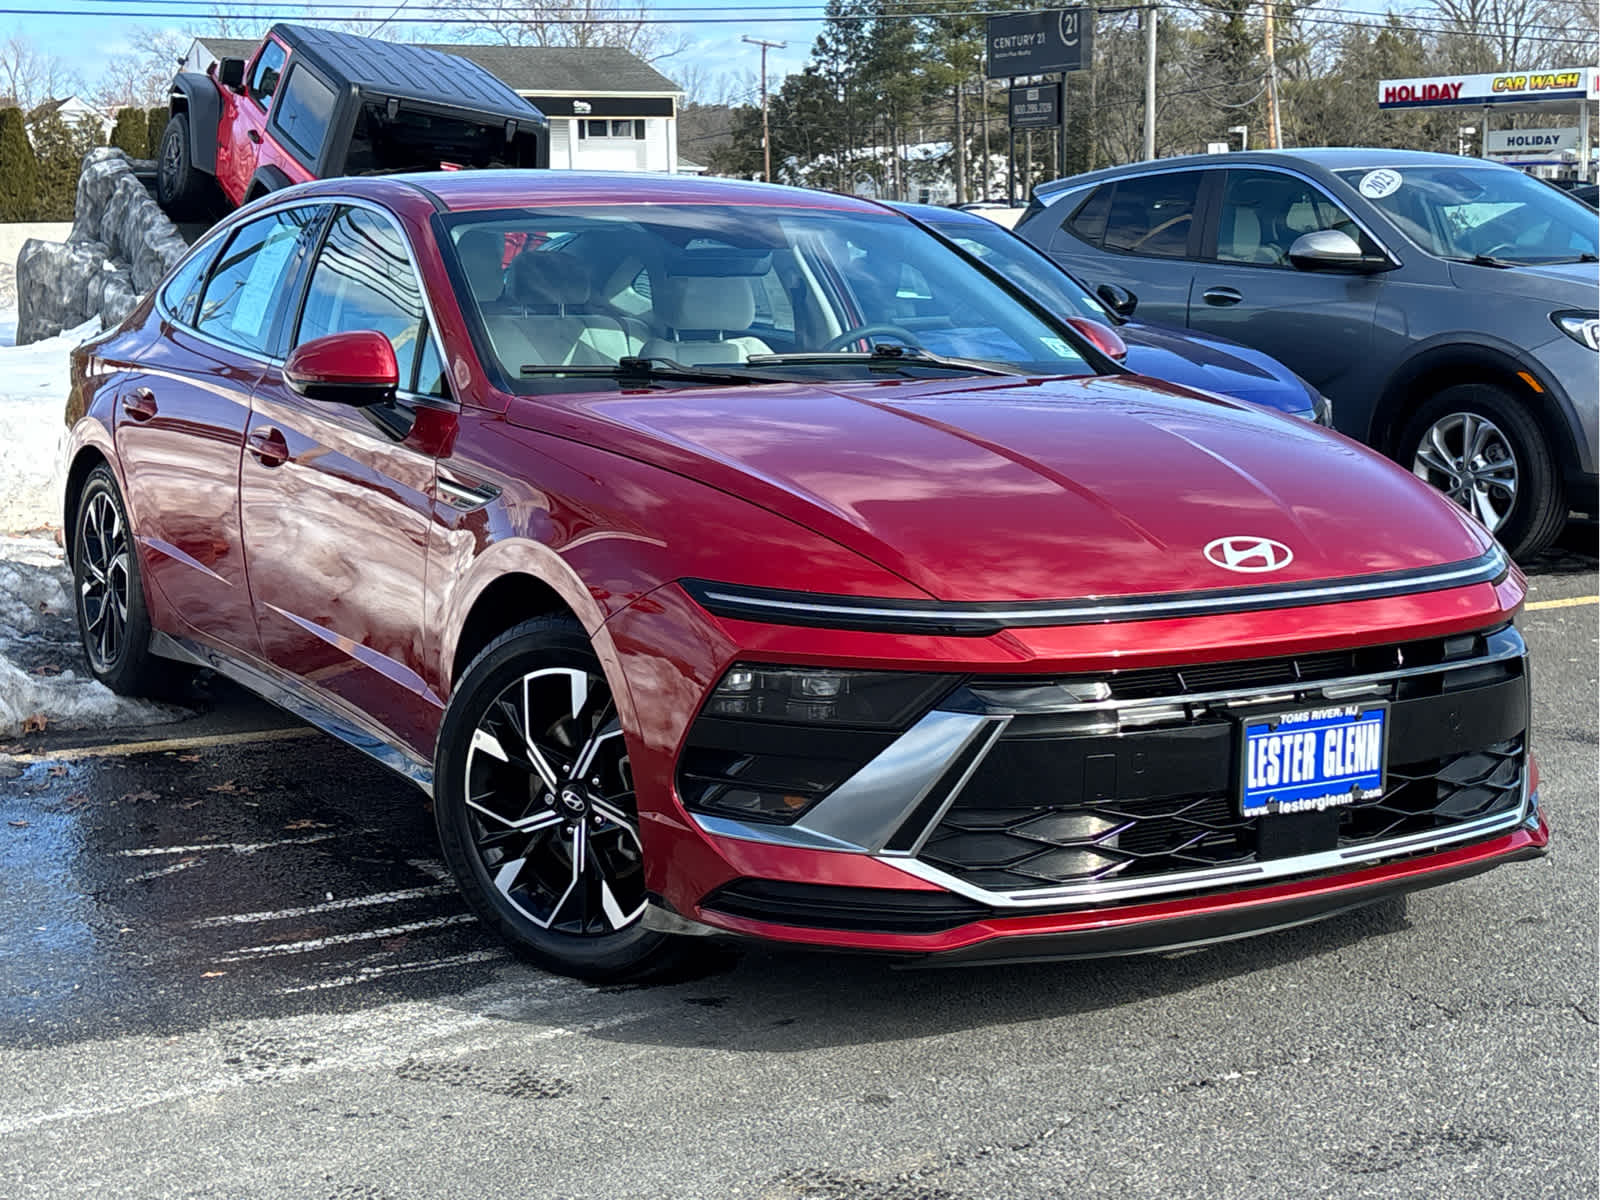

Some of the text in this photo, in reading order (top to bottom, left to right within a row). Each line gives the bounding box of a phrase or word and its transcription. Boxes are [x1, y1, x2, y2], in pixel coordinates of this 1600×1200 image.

[993, 32, 1046, 48] CENTURY 21
[1492, 72, 1581, 92] CAR WASH
[1384, 82, 1463, 103] HOLIDAY
[1507, 135, 1560, 146] HOLIDAY
[1366, 172, 1395, 194] 2023
[1280, 712, 1310, 724] TOMS
[1345, 705, 1359, 716] NJ
[1247, 723, 1381, 789] LESTER GLENN
